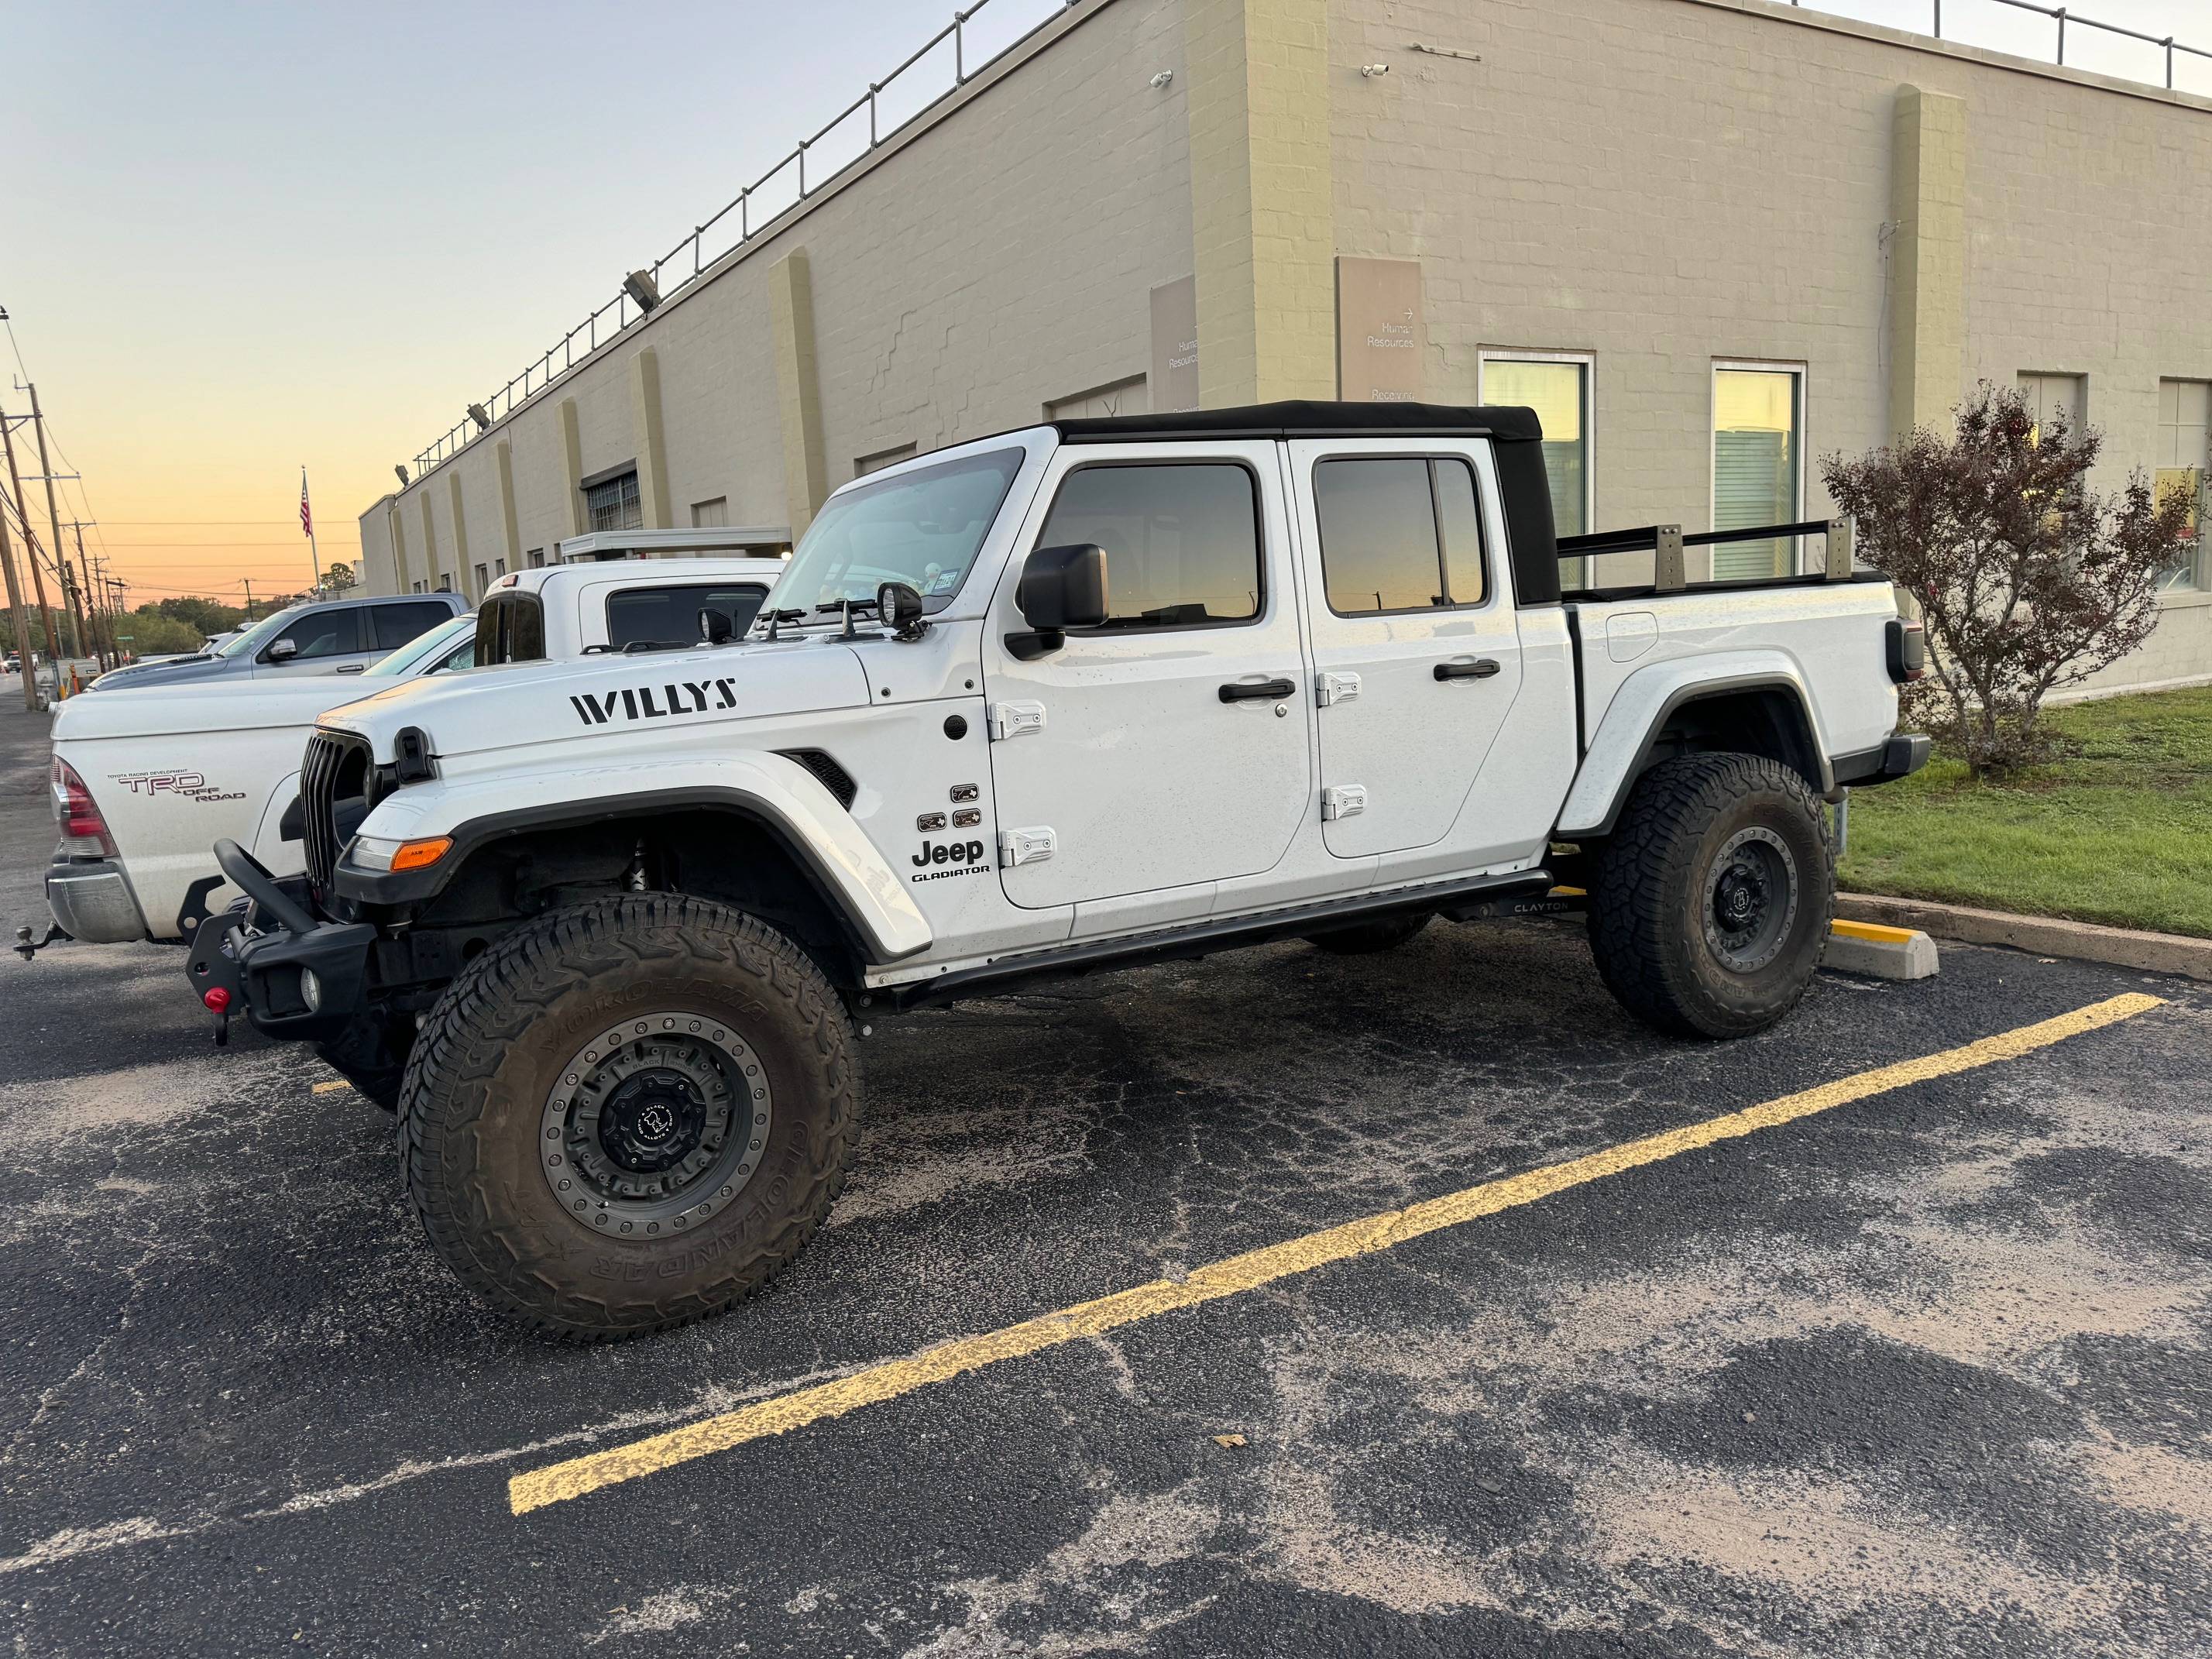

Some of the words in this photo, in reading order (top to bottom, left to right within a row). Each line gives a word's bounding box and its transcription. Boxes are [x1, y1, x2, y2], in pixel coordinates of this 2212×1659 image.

[1381, 322, 1413, 334] Human
[1367, 335, 1414, 348] Resources
[568, 677, 737, 725] WILLYS
[118, 772, 204, 796] TRD
[183, 787, 220, 796] OFF
[195, 792, 246, 802] ROAD
[912, 840, 984, 867] Jeep
[912, 865, 991, 882] GLADIATOR
[1513, 902, 1568, 913] CLAYTON
[632, 1058, 661, 1070] BLACK
[669, 1059, 694, 1073] RHINO
